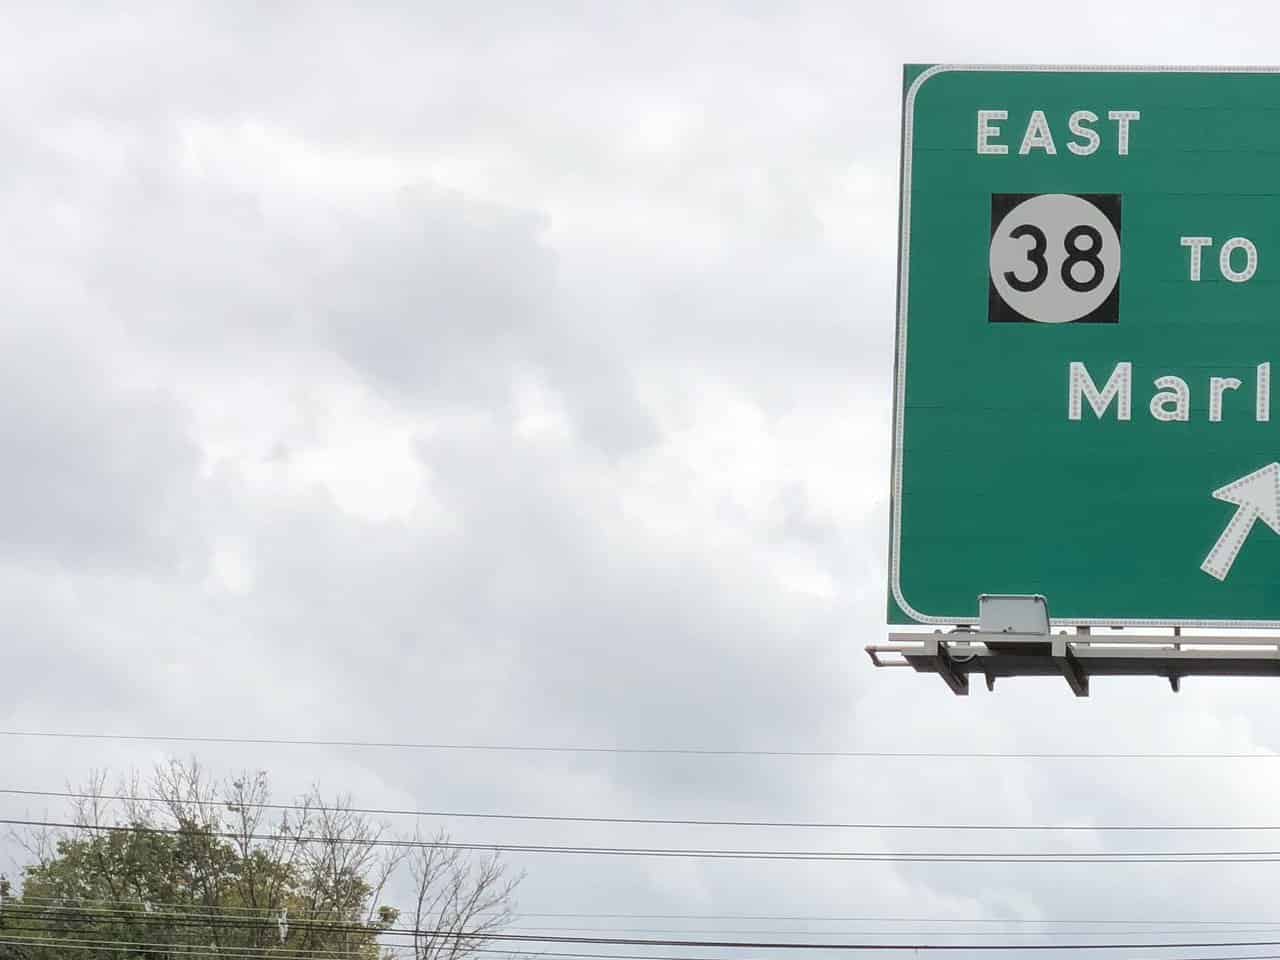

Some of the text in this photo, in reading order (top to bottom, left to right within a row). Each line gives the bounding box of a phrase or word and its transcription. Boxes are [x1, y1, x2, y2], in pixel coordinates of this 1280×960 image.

[976, 110, 1140, 155] EAST
[1003, 224, 1105, 293] 38
[1180, 236, 1259, 282] TO
